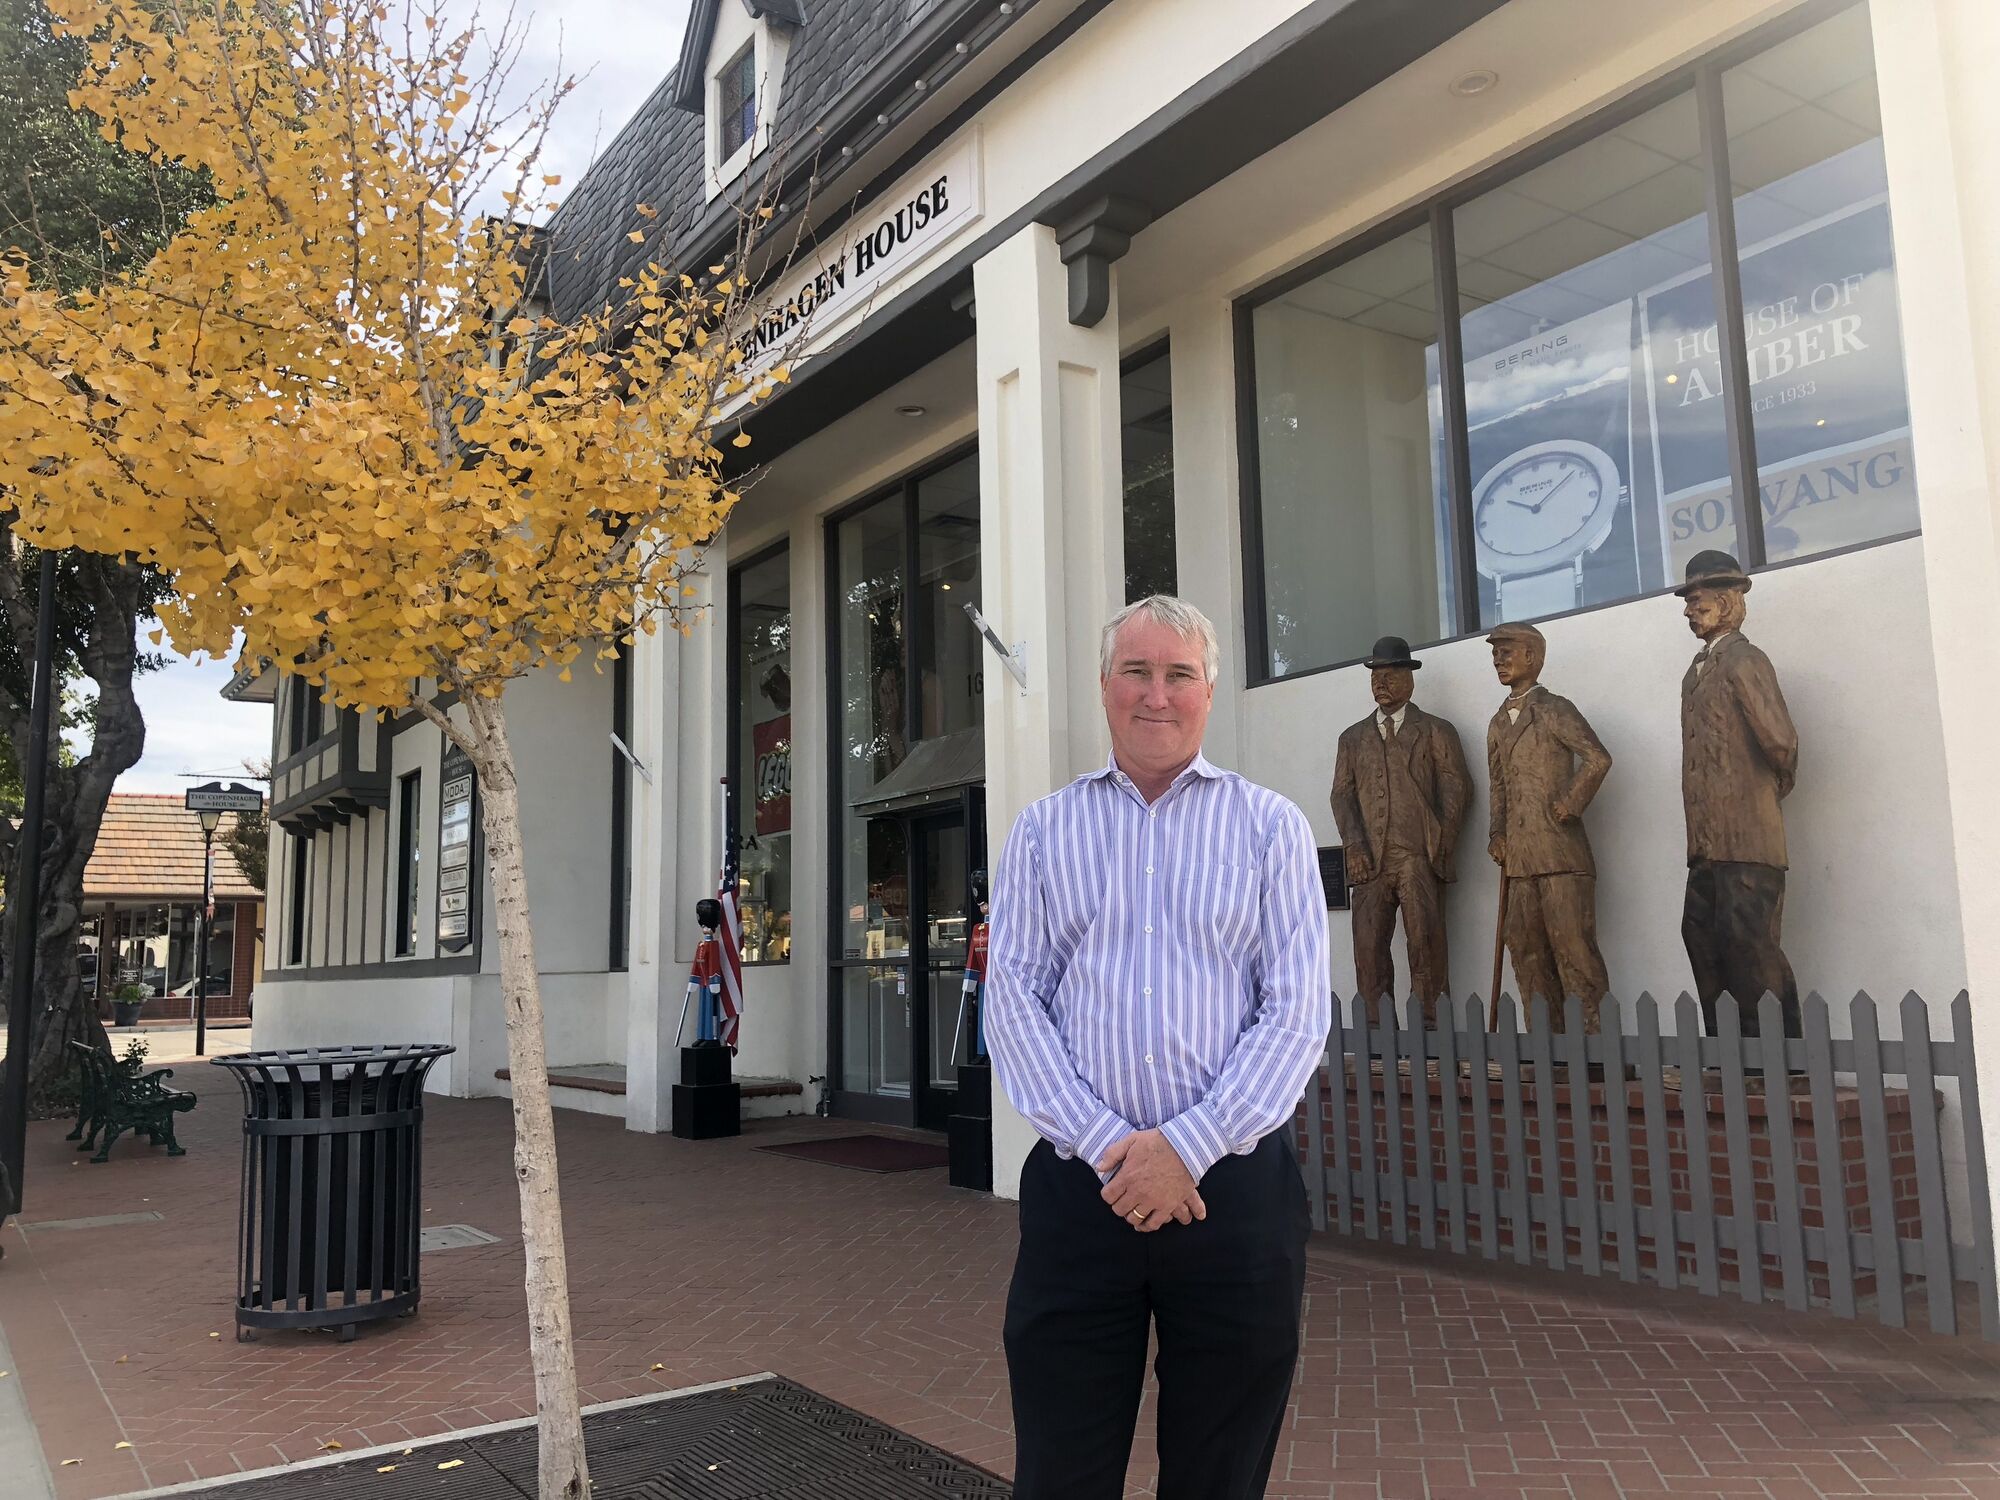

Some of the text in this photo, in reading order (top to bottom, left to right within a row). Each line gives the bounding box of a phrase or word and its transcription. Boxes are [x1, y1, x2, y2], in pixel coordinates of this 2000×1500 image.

[855, 175, 949, 277] HOUSE
[1810, 273, 1865, 314] OF
[1495, 334, 1568, 370] BERING
[1779, 380, 1817, 405] 1933
[208, 794, 260, 802] COPENHAGEN
[445, 783, 464, 798] MODA
